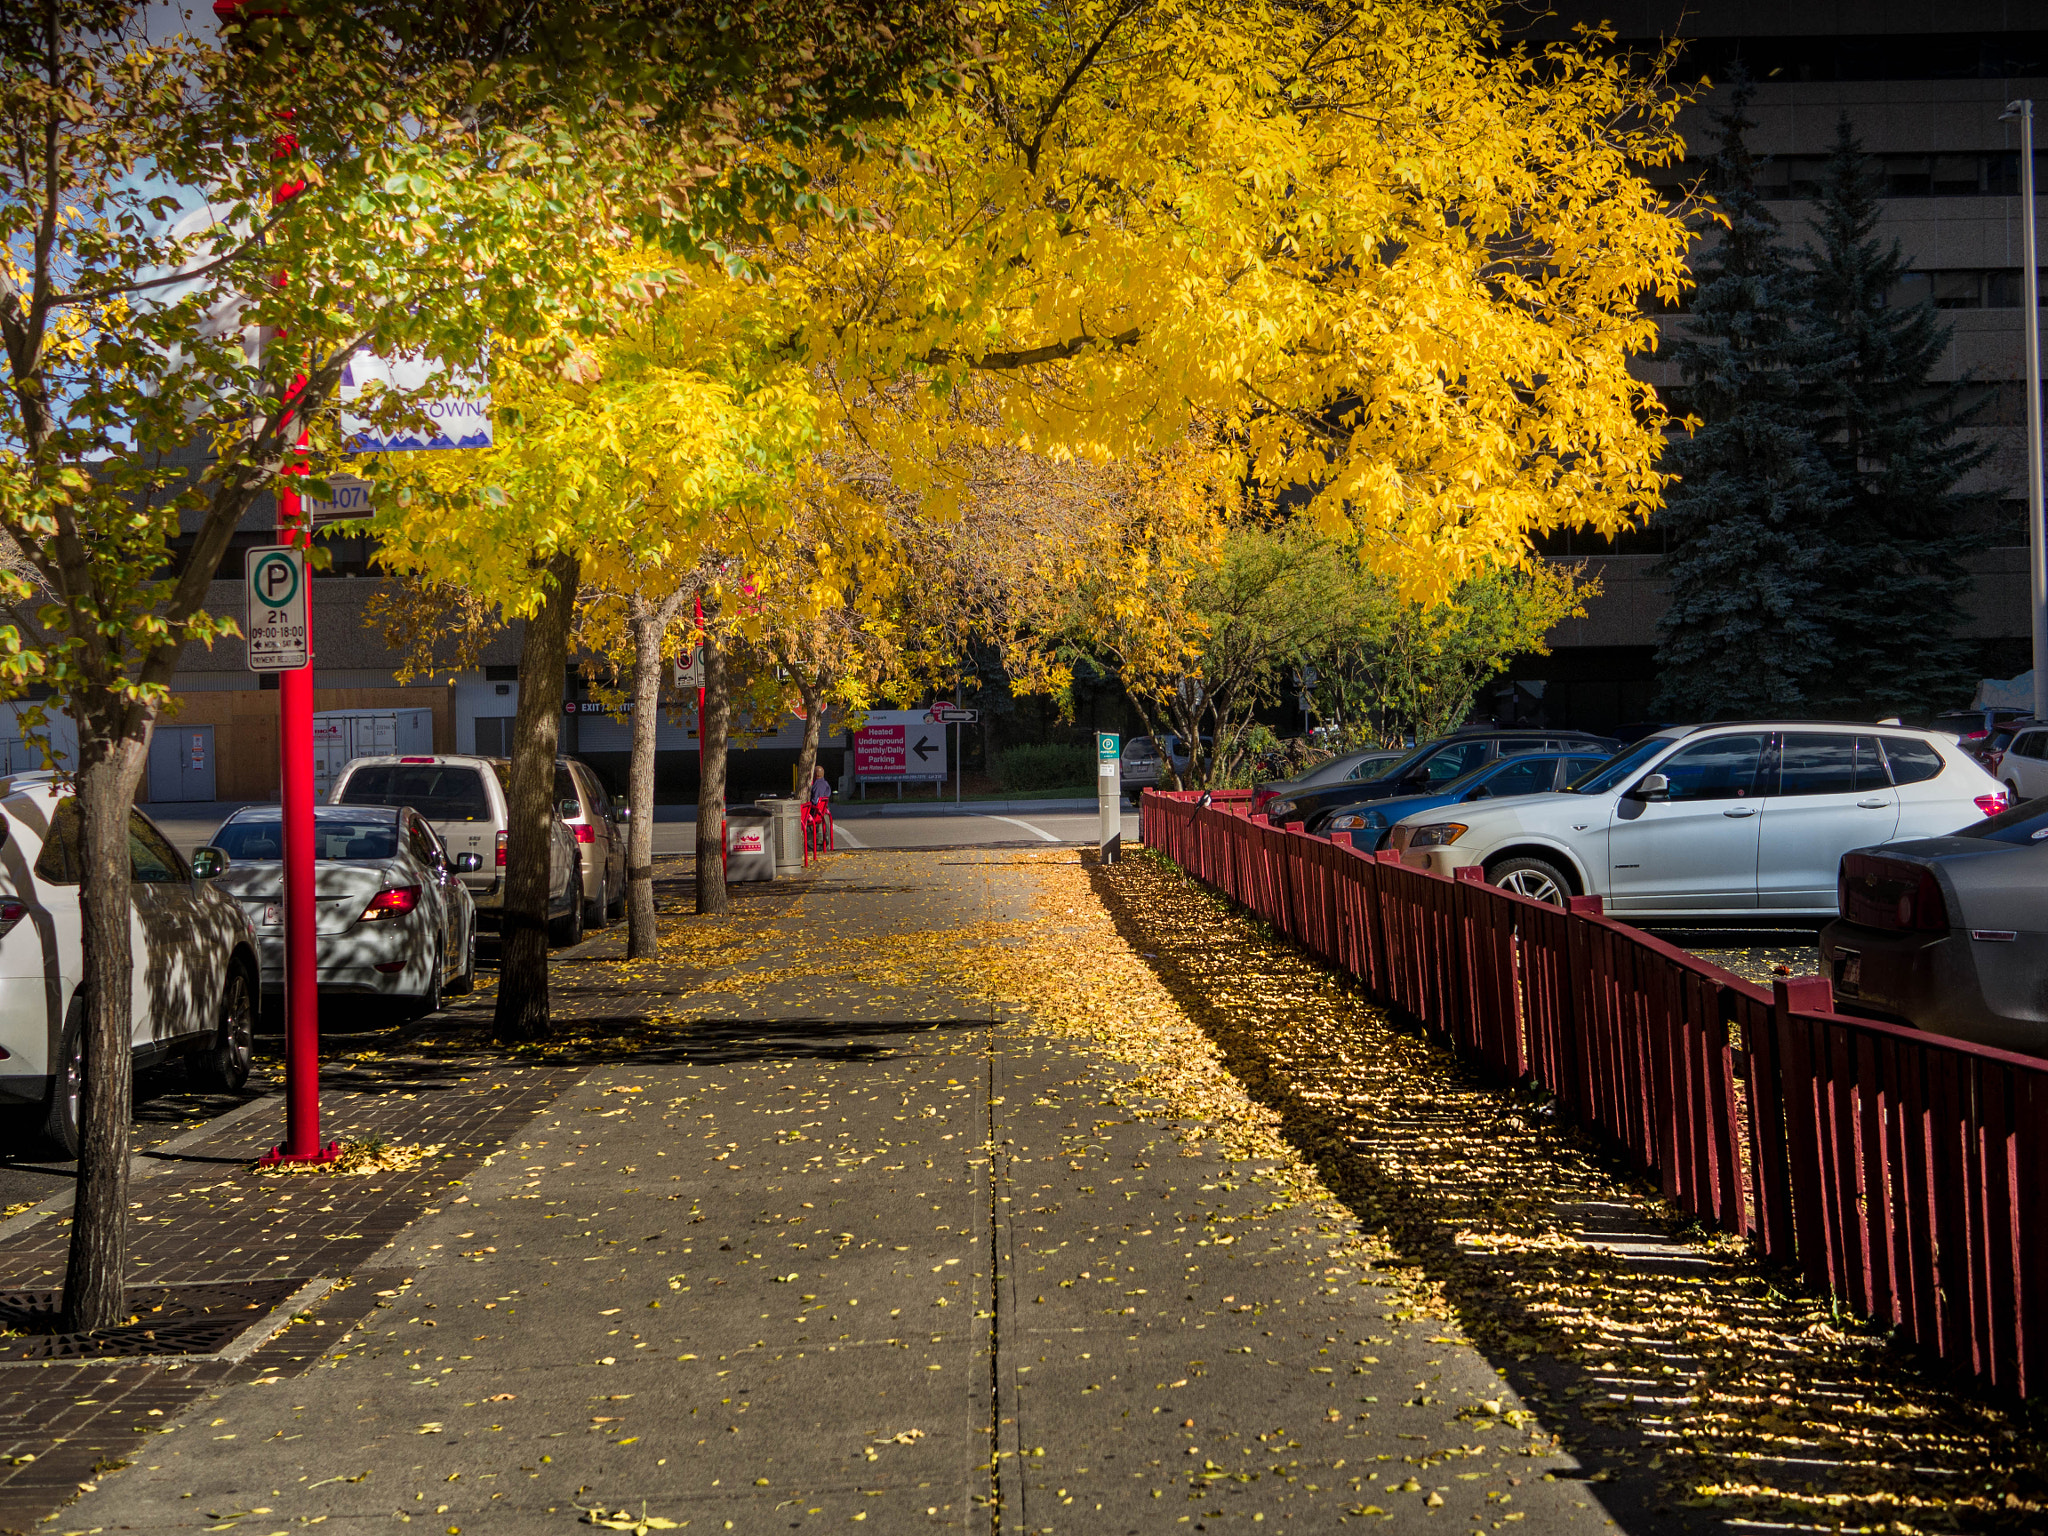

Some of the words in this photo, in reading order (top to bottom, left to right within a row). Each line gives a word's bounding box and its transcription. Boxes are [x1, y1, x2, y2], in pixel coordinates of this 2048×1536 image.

[267, 564, 289, 597] P
[268, 610, 277, 624] 2
[280, 610, 288, 623] h
[252, 626, 304, 639] 09:00-18:00
[581, 703, 600, 712] EXIT
[868, 728, 893, 736] Heated
[858, 738, 904, 746] Underground
[858, 746, 905, 755] Monthly/Daily
[868, 756, 895, 764] Parking
